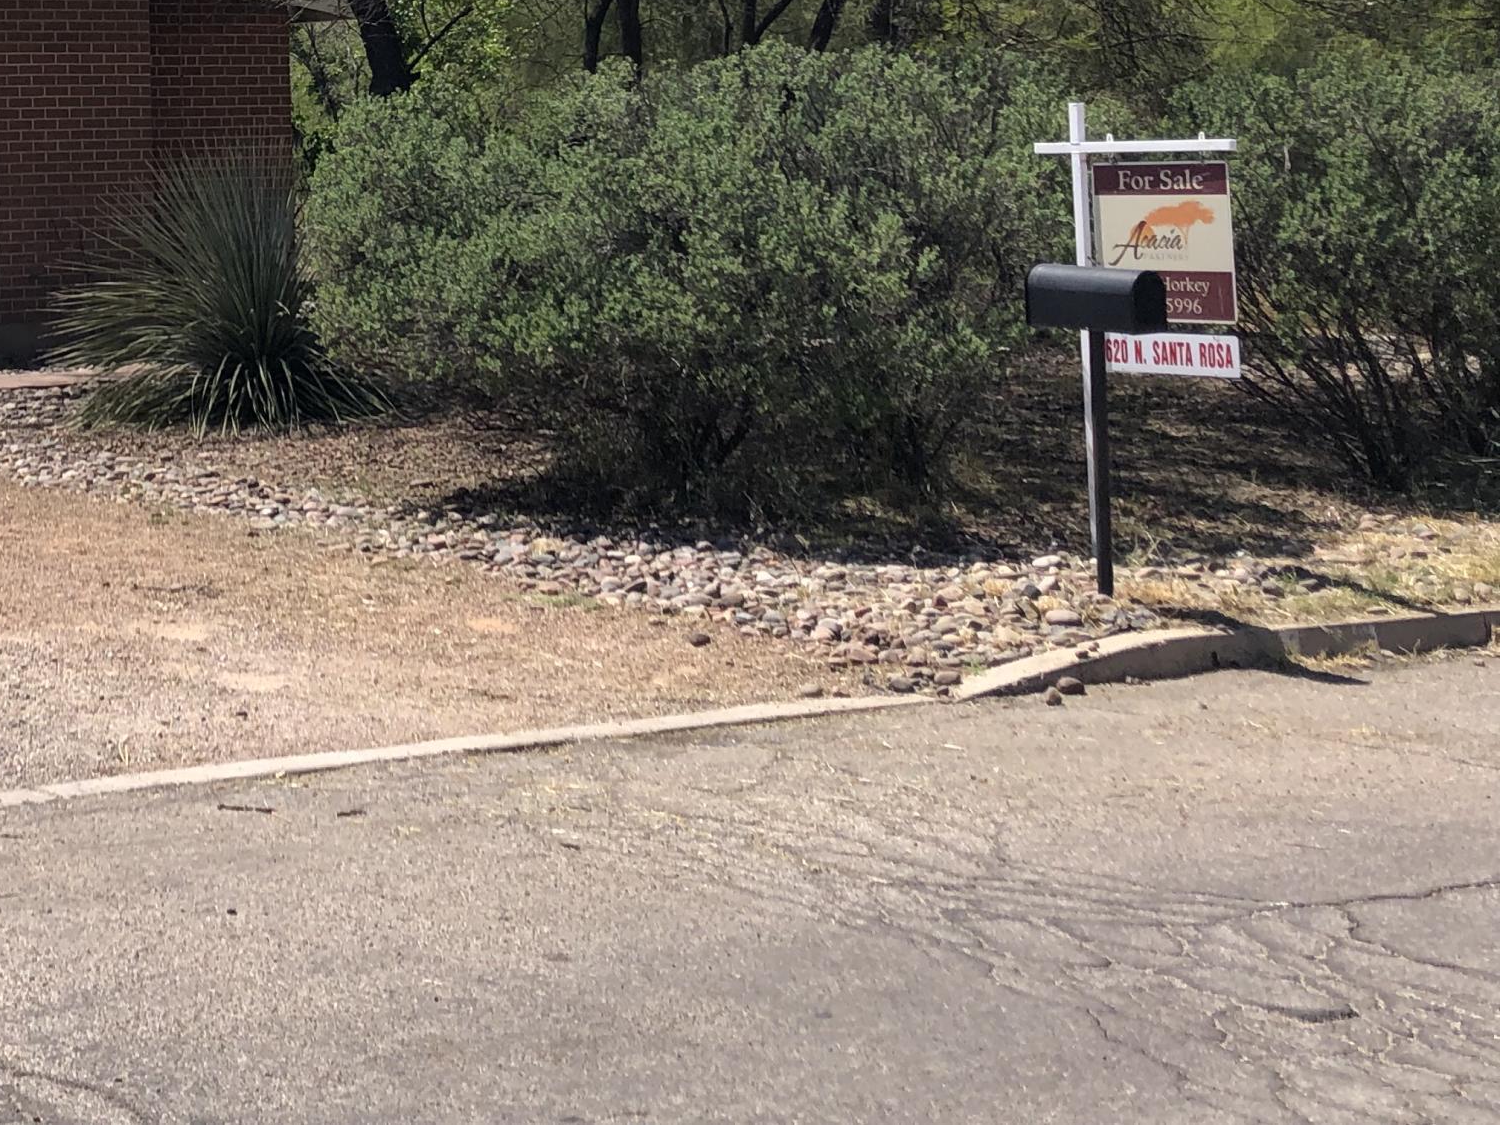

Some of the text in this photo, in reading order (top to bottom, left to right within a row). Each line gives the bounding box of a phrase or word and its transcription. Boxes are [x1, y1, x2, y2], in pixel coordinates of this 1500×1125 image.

[1118, 169, 1204, 190] For Sale
[1108, 220, 1183, 266] Acacia
[1166, 298, 1203, 315] 5996
[1134, 340, 1147, 364] N.
[1152, 341, 1194, 367] SANTA
[1199, 343, 1234, 369] ROSA
